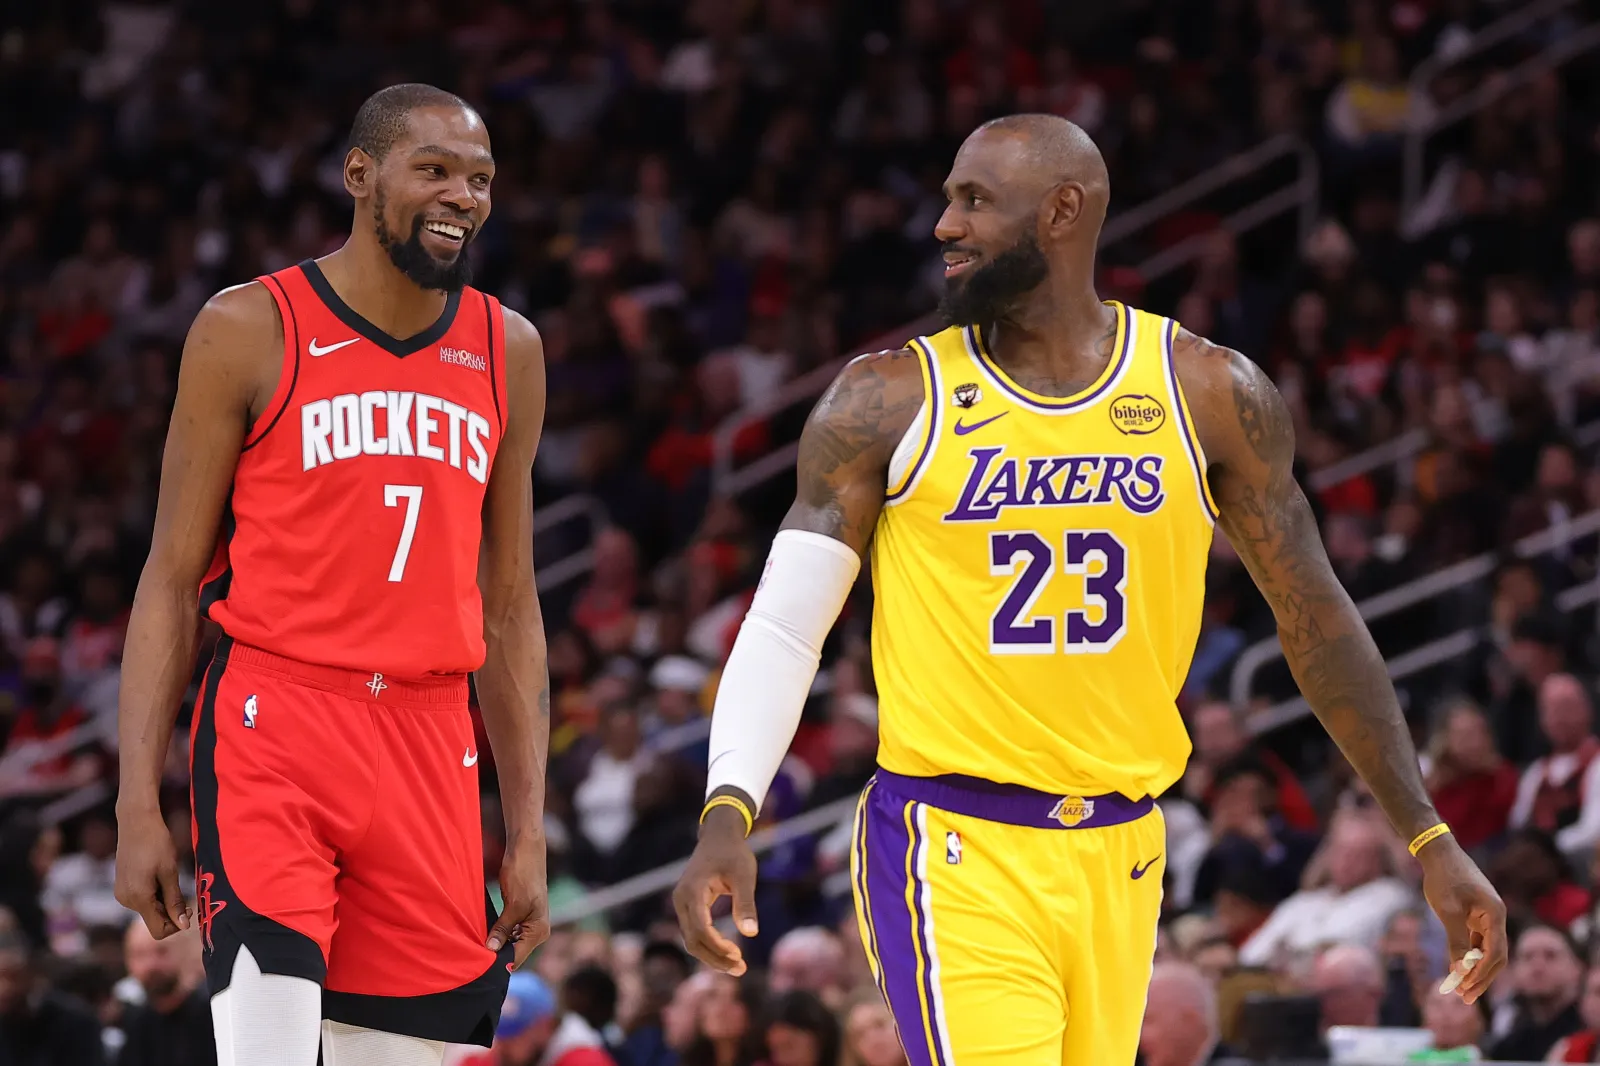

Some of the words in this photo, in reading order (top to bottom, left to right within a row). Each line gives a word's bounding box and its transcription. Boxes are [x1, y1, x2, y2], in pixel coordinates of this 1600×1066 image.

[440, 346, 486, 364] MEMORIAL
[440, 353, 486, 371] HERMANN
[301, 390, 490, 485] ROCKETS
[1113, 405, 1161, 423] bibigo
[941, 445, 1166, 523] LAKERS
[383, 484, 424, 583] 7
[988, 529, 1128, 655] 23
